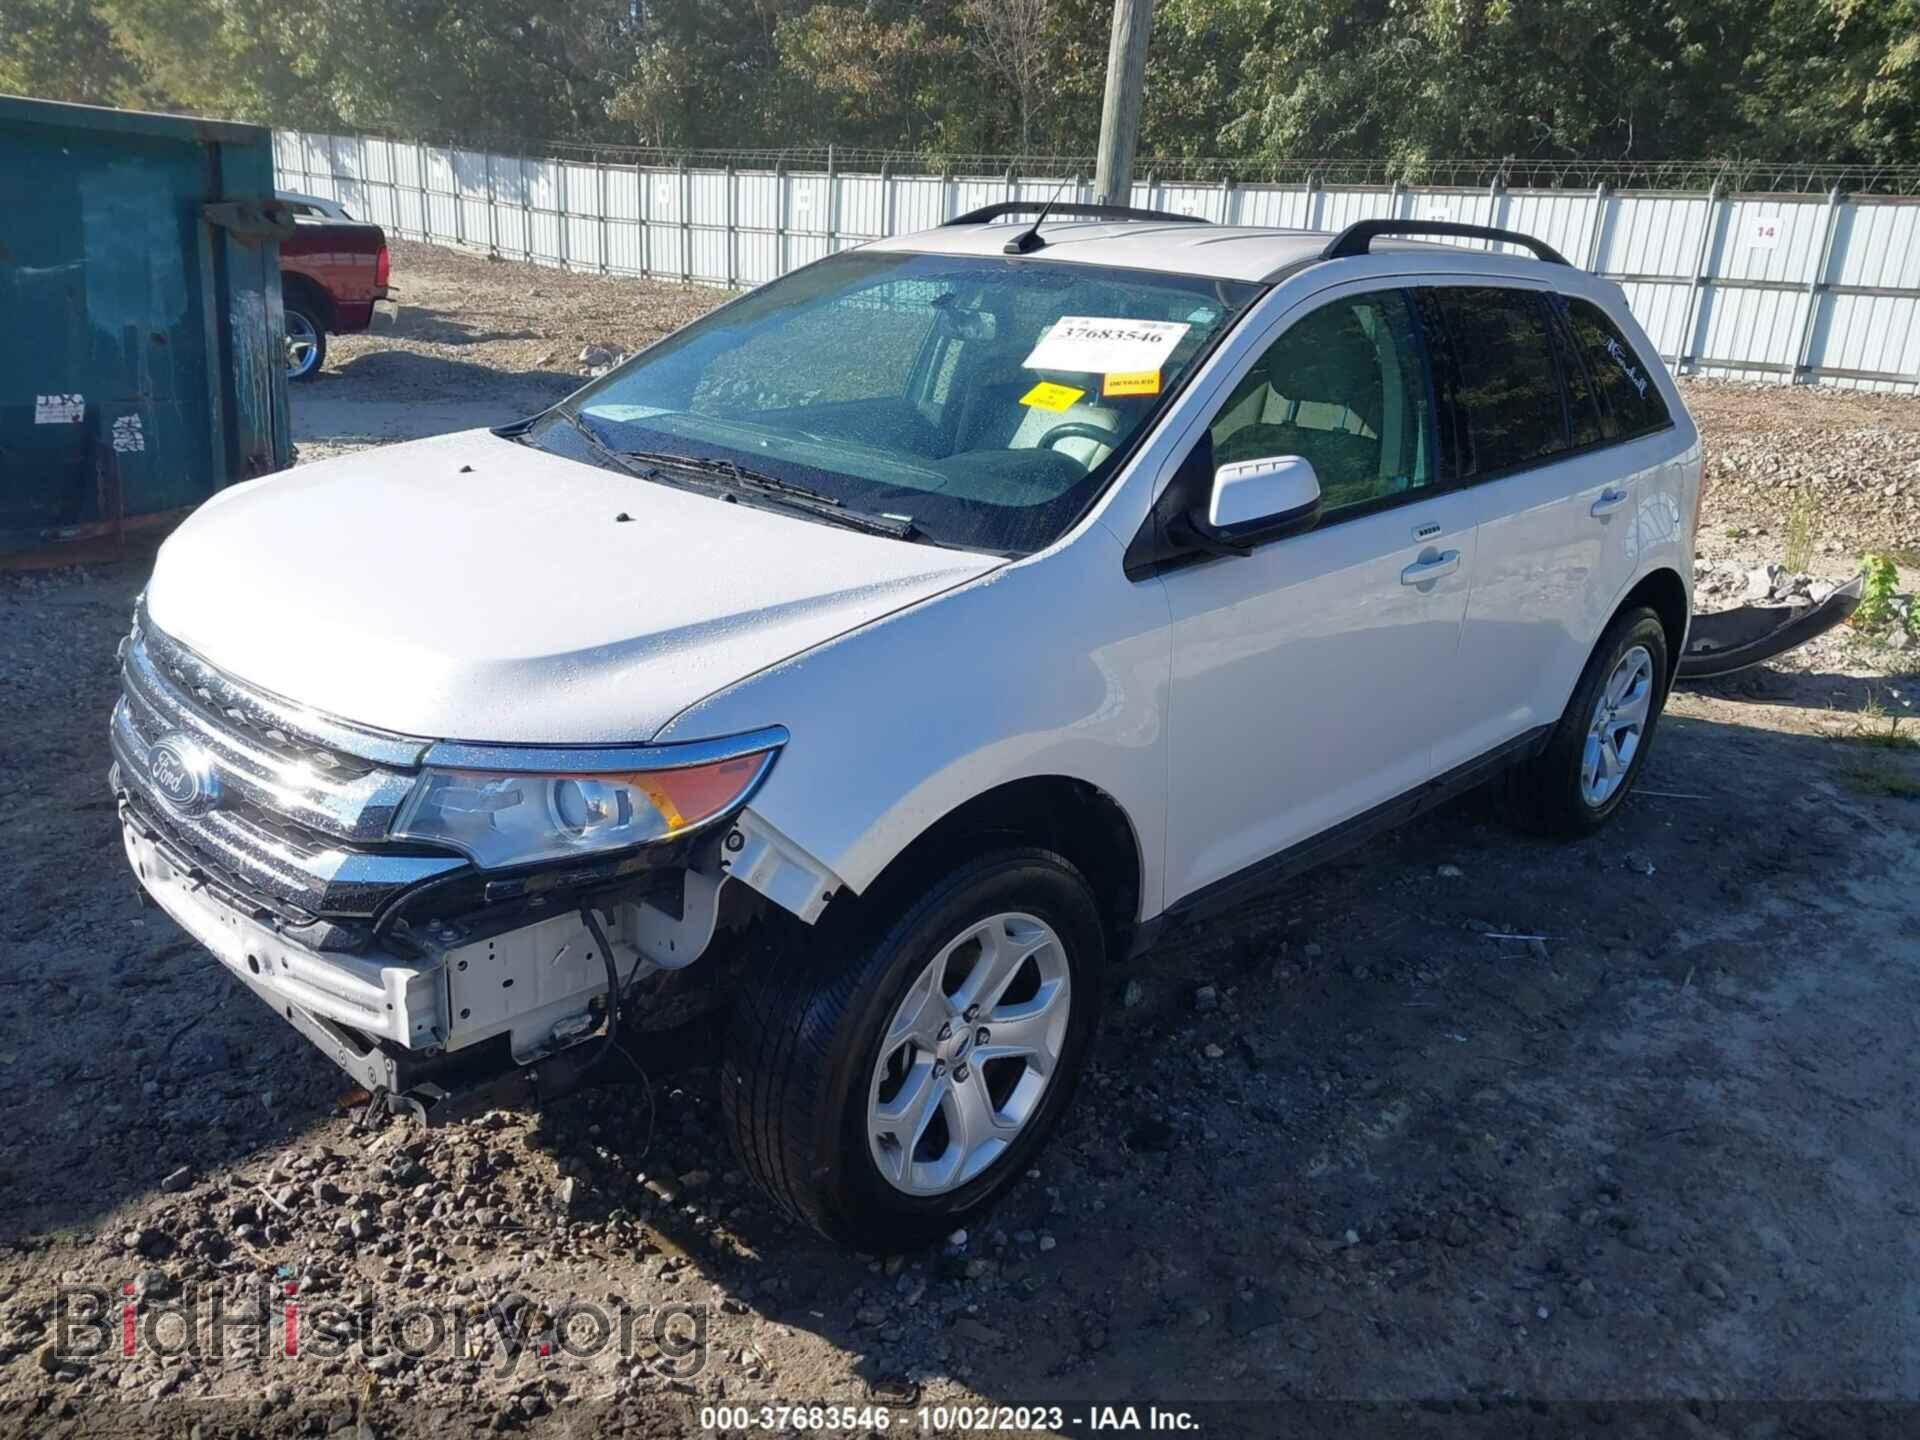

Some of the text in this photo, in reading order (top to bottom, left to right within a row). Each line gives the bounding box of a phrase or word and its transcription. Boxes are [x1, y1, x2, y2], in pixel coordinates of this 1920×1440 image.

[1758, 226, 1775, 238] 14
[1061, 327, 1163, 343] 37683546
[152, 750, 185, 793] Ford
